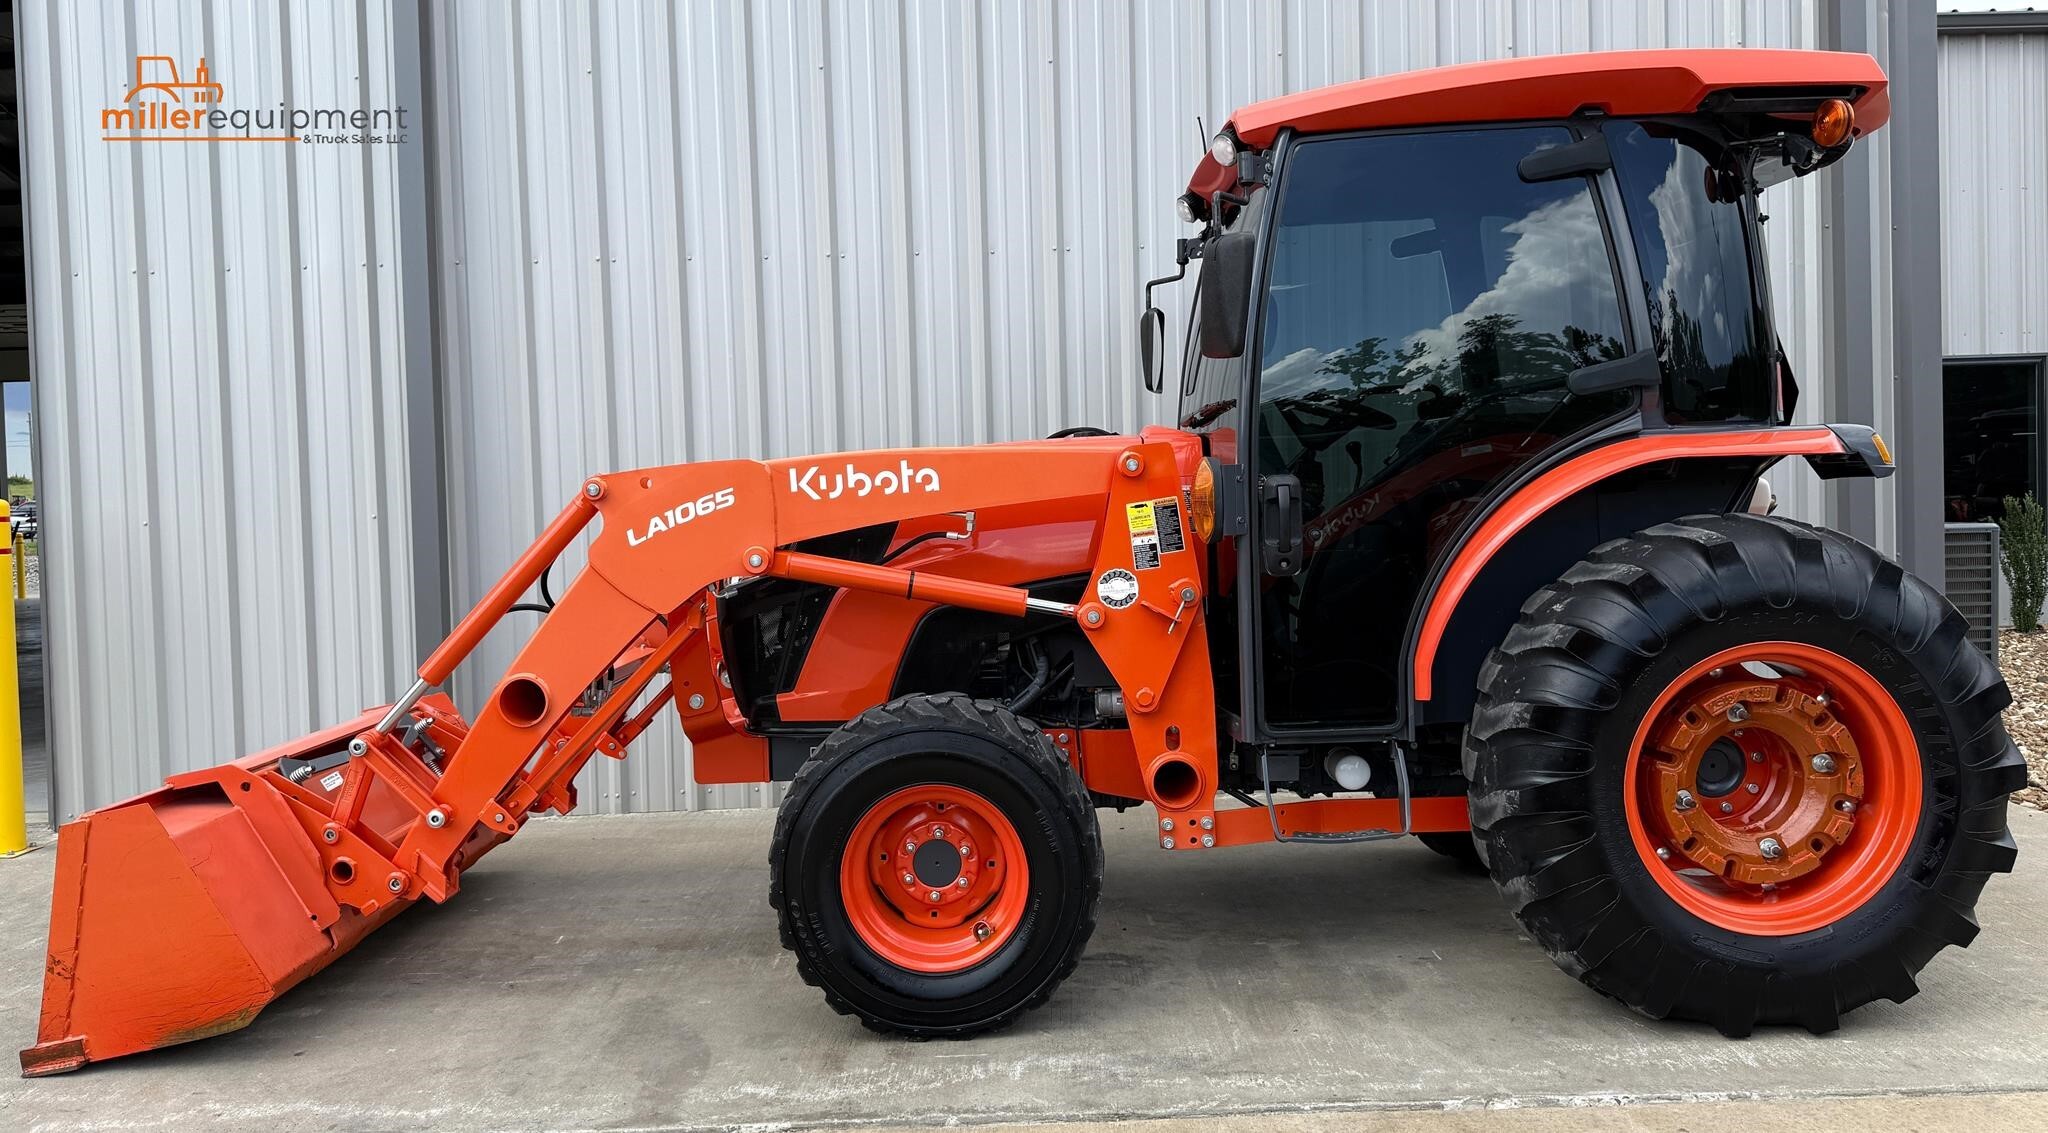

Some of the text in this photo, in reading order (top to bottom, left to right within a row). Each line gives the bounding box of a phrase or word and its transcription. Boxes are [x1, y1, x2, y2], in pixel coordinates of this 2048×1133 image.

[789, 459, 940, 501] Kubota
[625, 487, 735, 547] LA1065
[1898, 674, 1959, 823] TITAN
